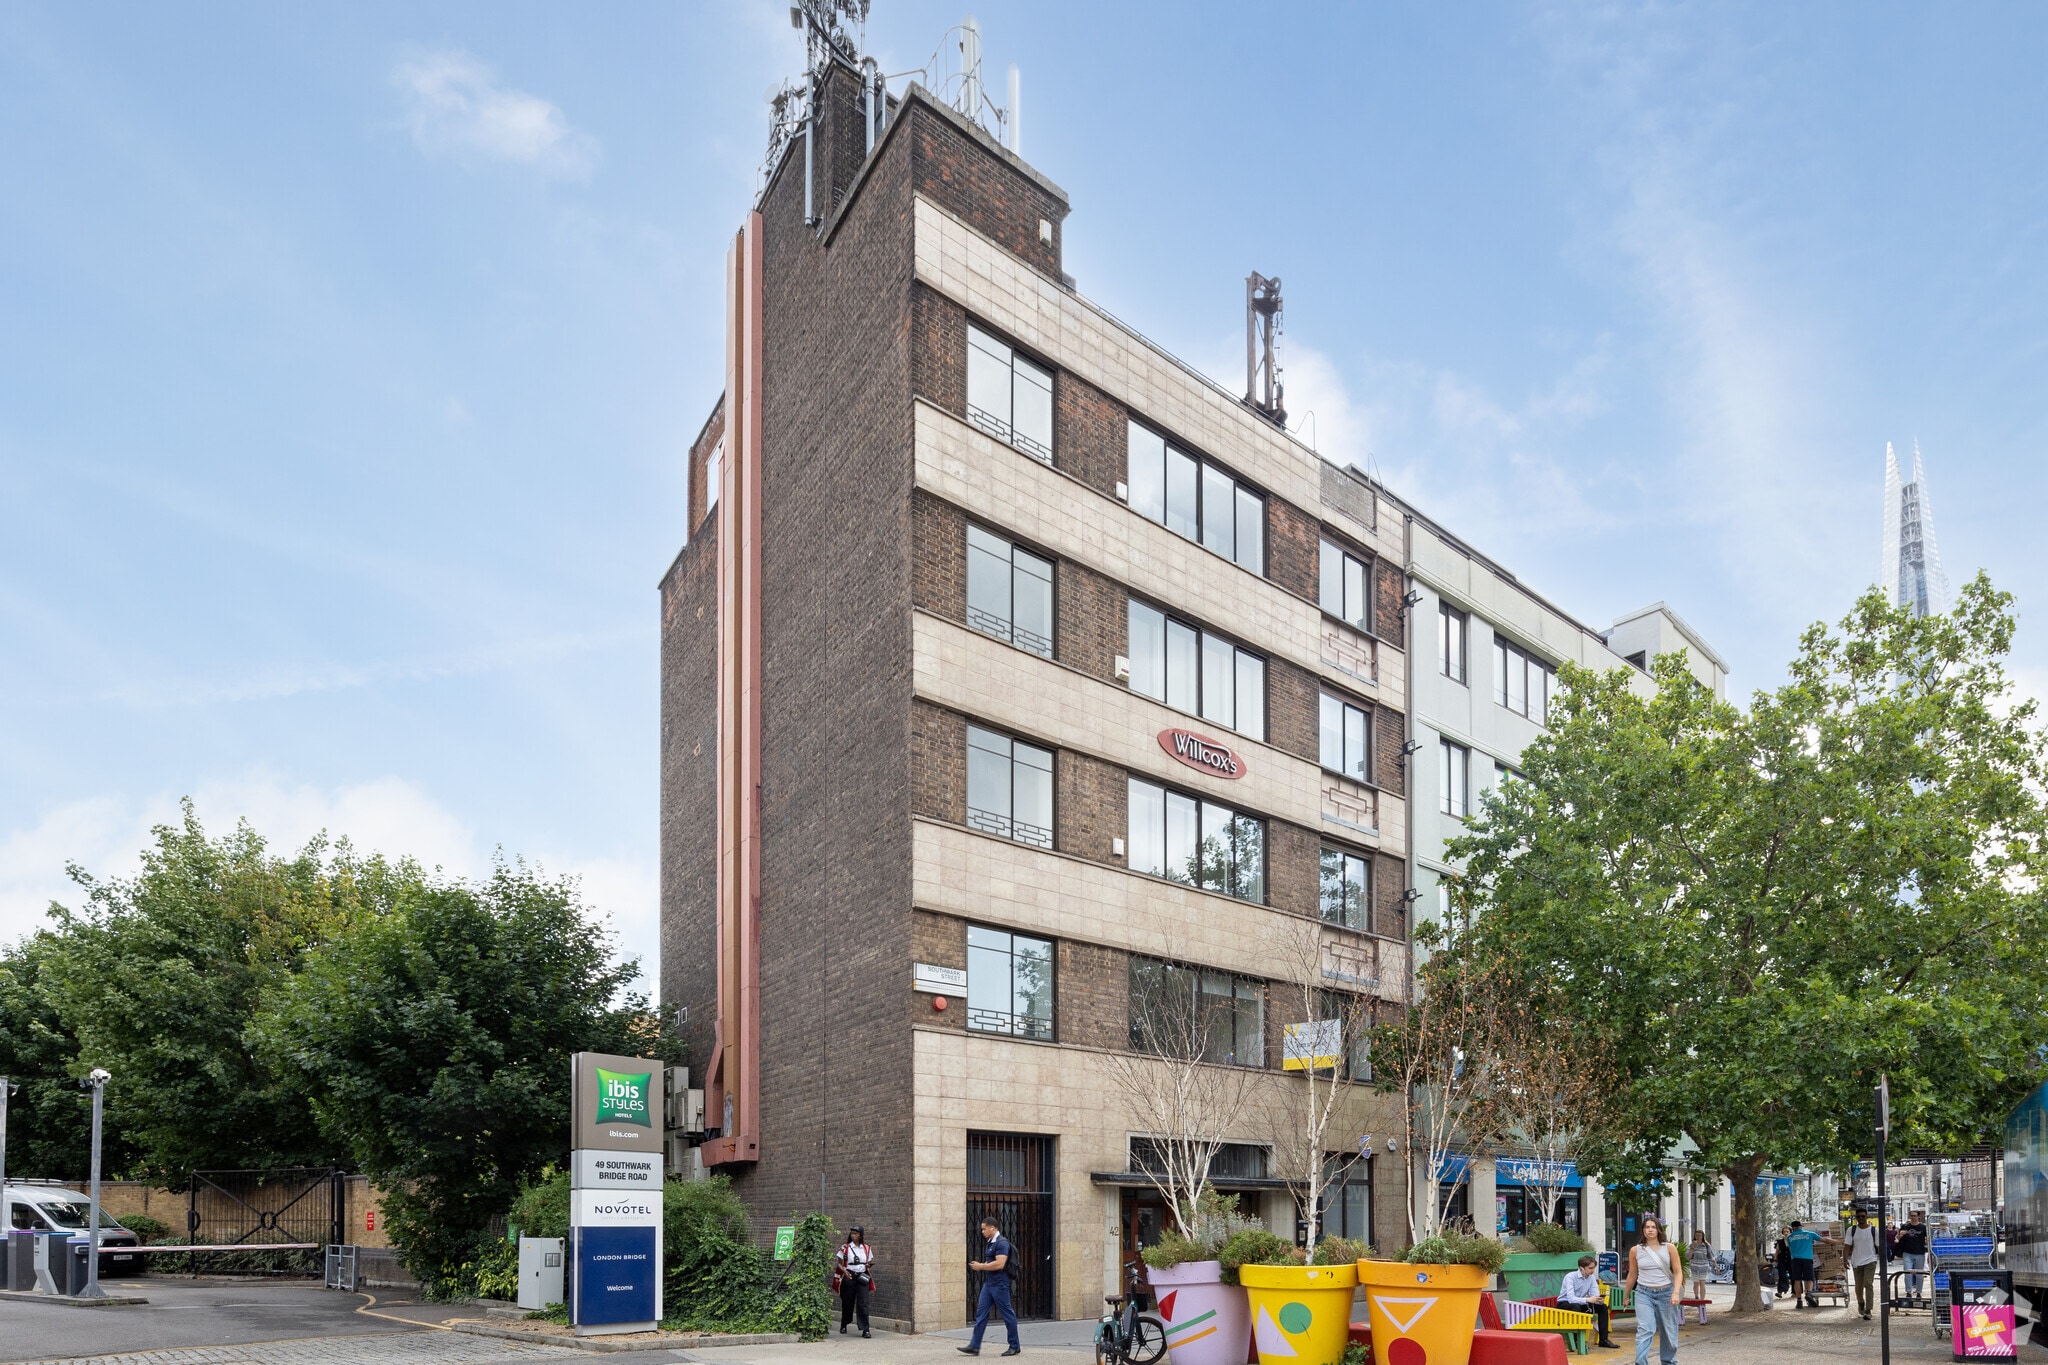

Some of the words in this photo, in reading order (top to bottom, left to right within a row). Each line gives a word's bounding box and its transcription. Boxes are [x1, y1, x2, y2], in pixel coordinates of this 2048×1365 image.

[1172, 732, 1237, 774] Willcox's
[927, 966, 961, 976] SOUTHWARK
[608, 1079, 639, 1099] ibis
[609, 1130, 639, 1138] ibis.com
[595, 1160, 605, 1169] 49
[606, 1161, 652, 1170] SOUTHWARK
[599, 1172, 626, 1180] BRIDGE
[628, 1173, 648, 1181] ROAD
[594, 1205, 652, 1214] NOVOTEL
[1109, 1226, 1119, 1236] 42
